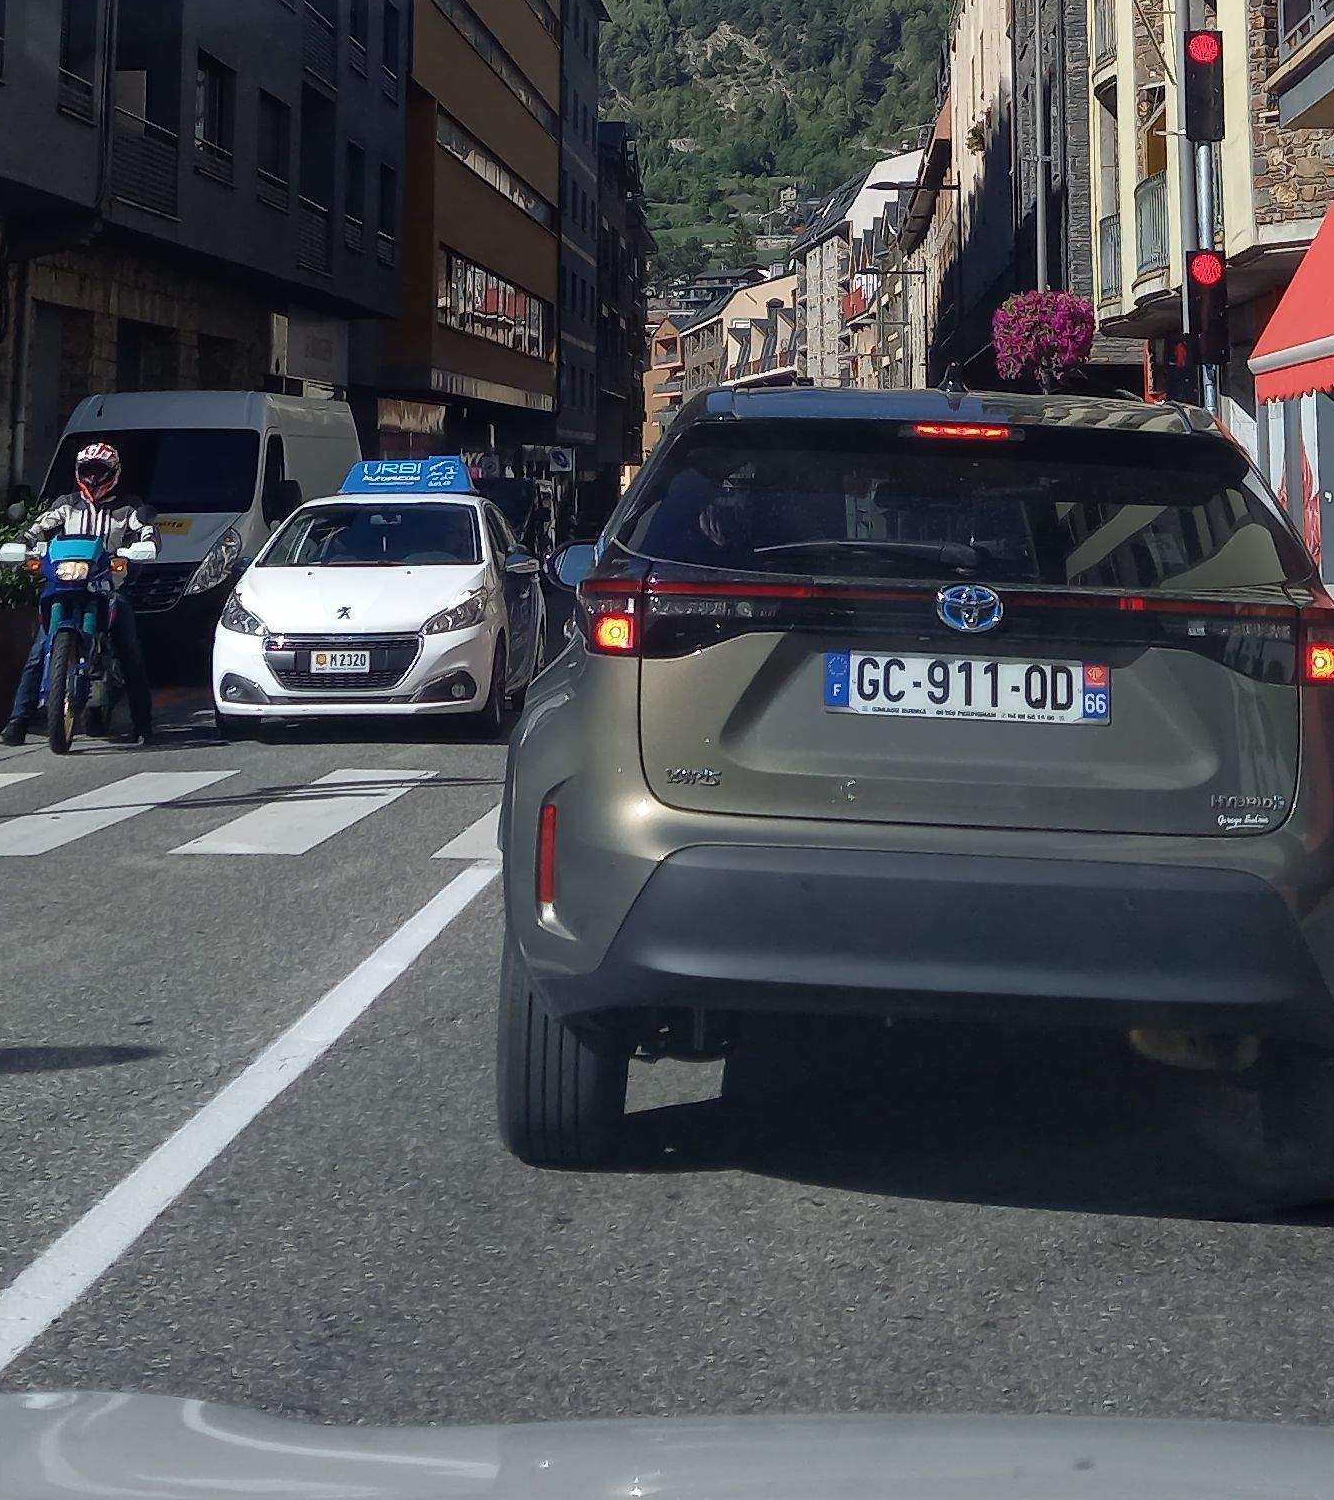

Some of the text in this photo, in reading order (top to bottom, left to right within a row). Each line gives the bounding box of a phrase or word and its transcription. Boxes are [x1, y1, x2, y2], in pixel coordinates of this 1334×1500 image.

[833, 683, 842, 697] F
[856, 656, 1073, 712] GC-911-QD
[1084, 693, 1107, 714] 66
